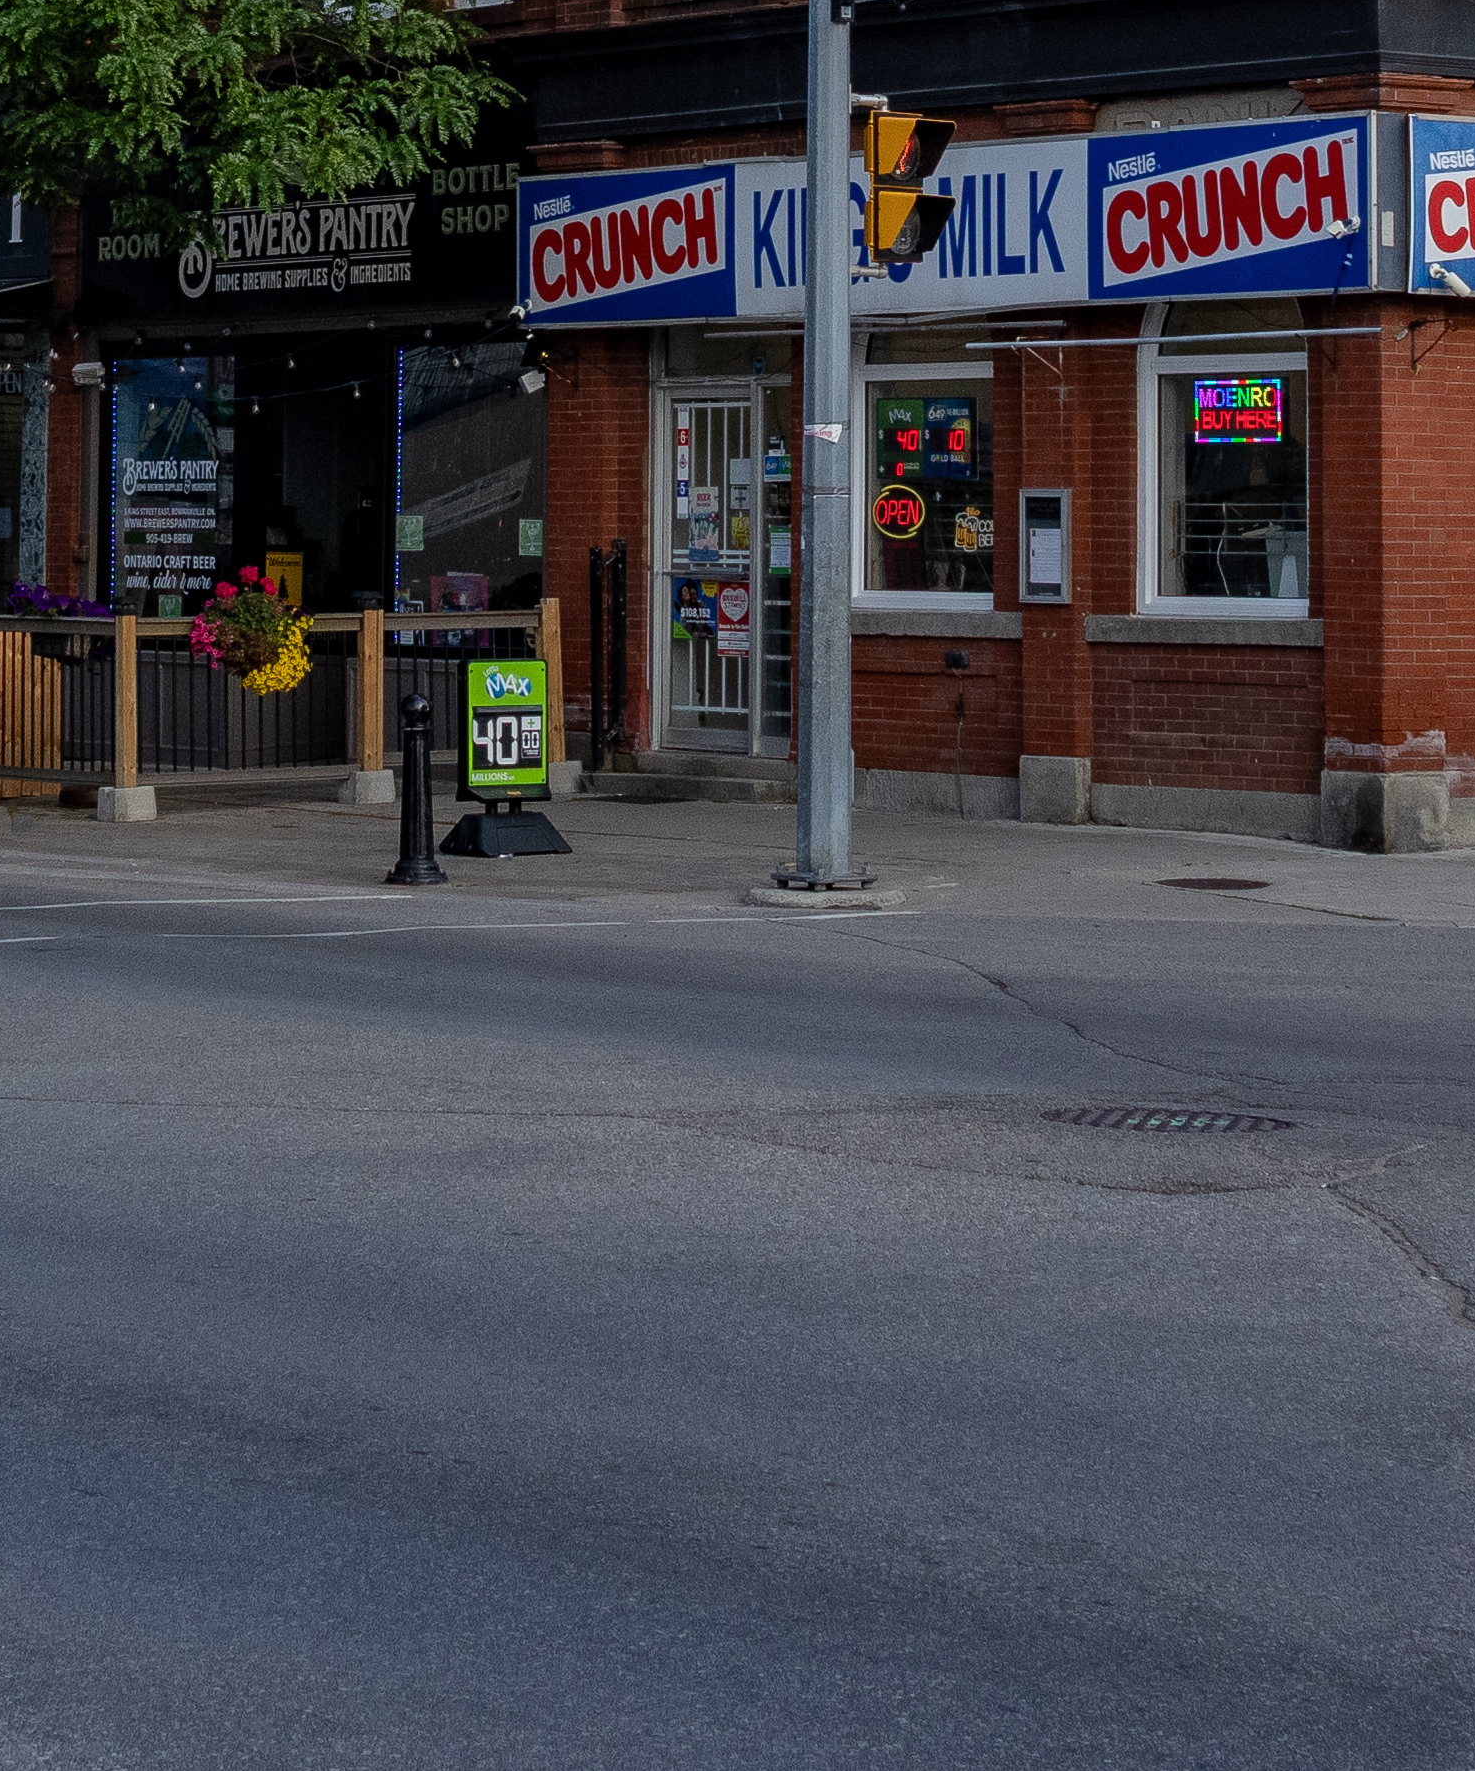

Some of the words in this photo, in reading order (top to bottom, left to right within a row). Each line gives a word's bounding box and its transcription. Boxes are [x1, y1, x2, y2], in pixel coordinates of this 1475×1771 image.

[432, 162, 521, 197] BOTTLE
[441, 203, 511, 236] SHOP
[1106, 139, 1349, 275] CRUNCH
[319, 200, 416, 253] PANTRY
[938, 168, 1066, 279] MILK
[98, 232, 162, 262] ROOM
[531, 185, 719, 303] CRUNCH
[215, 272, 241, 293] HOME
[242, 270, 283, 291] BREWING
[284, 267, 329, 289] SUPPLIES
[350, 261, 412, 285] INGREDIENTS
[1198, 386, 1277, 408] MOENRO
[1201, 410, 1233, 430] BUY
[1235, 410, 1277, 430] HERE
[896, 429, 919, 451] 40
[949, 429, 964, 451] 10
[122, 456, 178, 496] BREWER'S
[179, 459, 219, 480] PANTRY
[875, 499, 920, 525] OPEN
[123, 555, 163, 568] ONTARIO
[163, 555, 192, 569] CRAFT
[192, 555, 216, 570] BEER
[152, 569, 177, 589] cider
[486, 672, 530, 699] MAX
[472, 716, 519, 766] 40
[471, 772, 509, 782] MILLIONS
